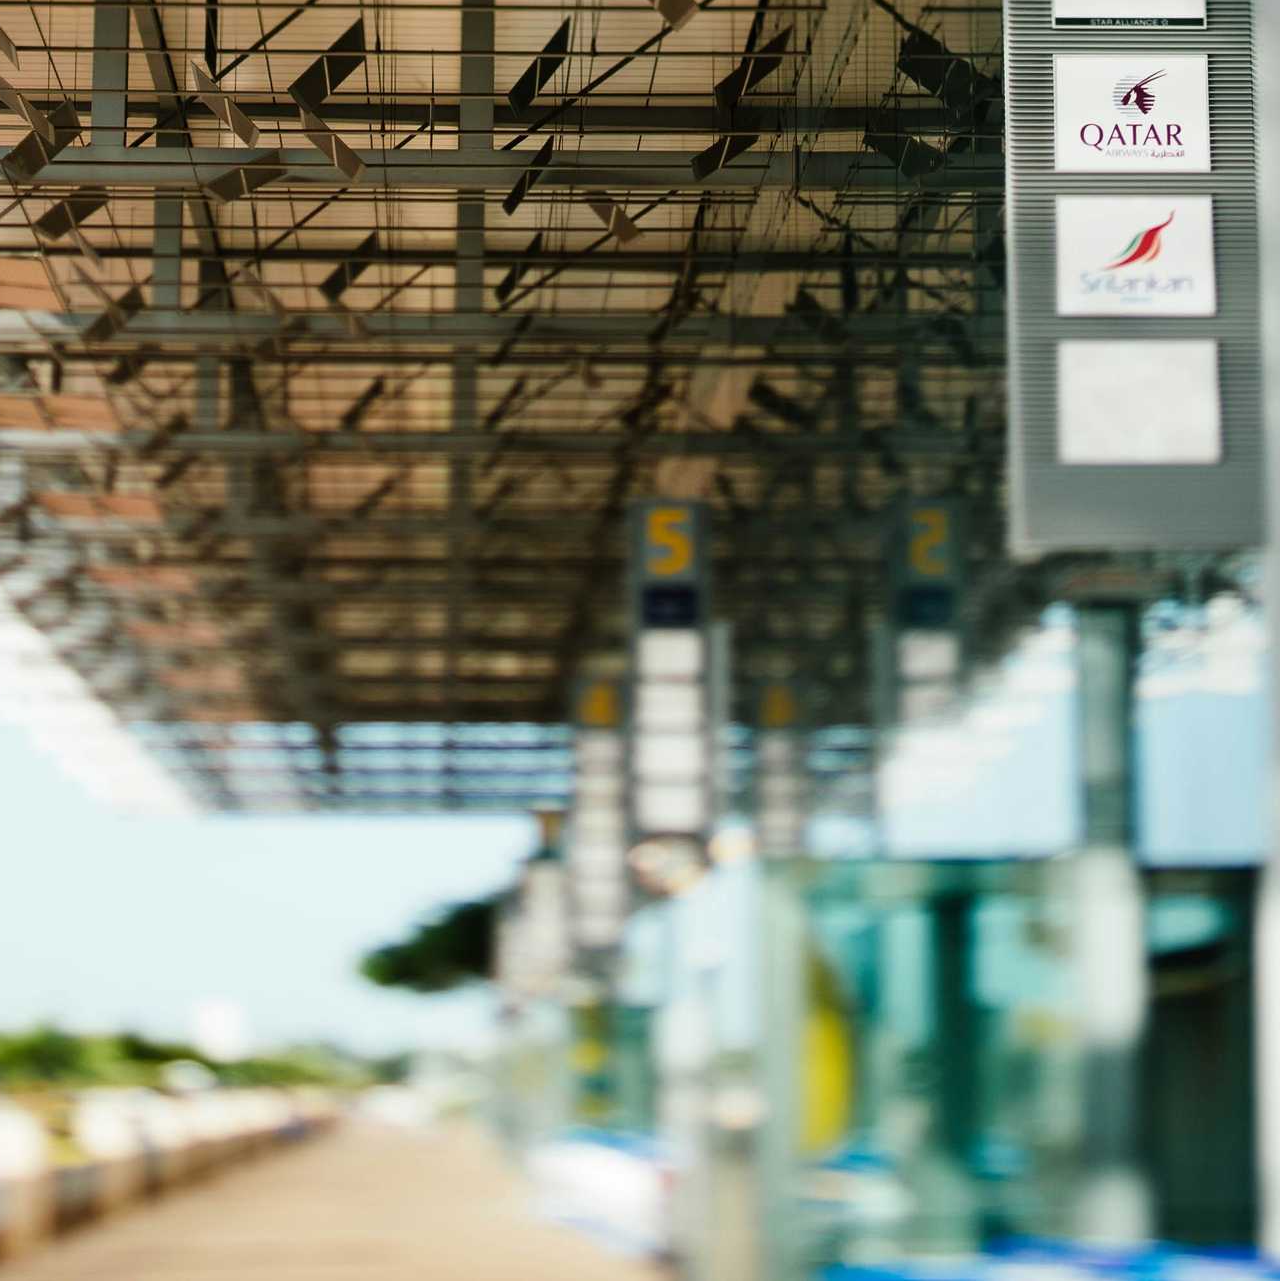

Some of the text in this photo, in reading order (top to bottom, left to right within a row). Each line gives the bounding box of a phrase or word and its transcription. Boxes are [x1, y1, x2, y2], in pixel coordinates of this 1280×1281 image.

[1079, 122, 1184, 152] QATAR
[1105, 149, 1149, 158] AIRWAYS
[646, 508, 694, 575] 5
